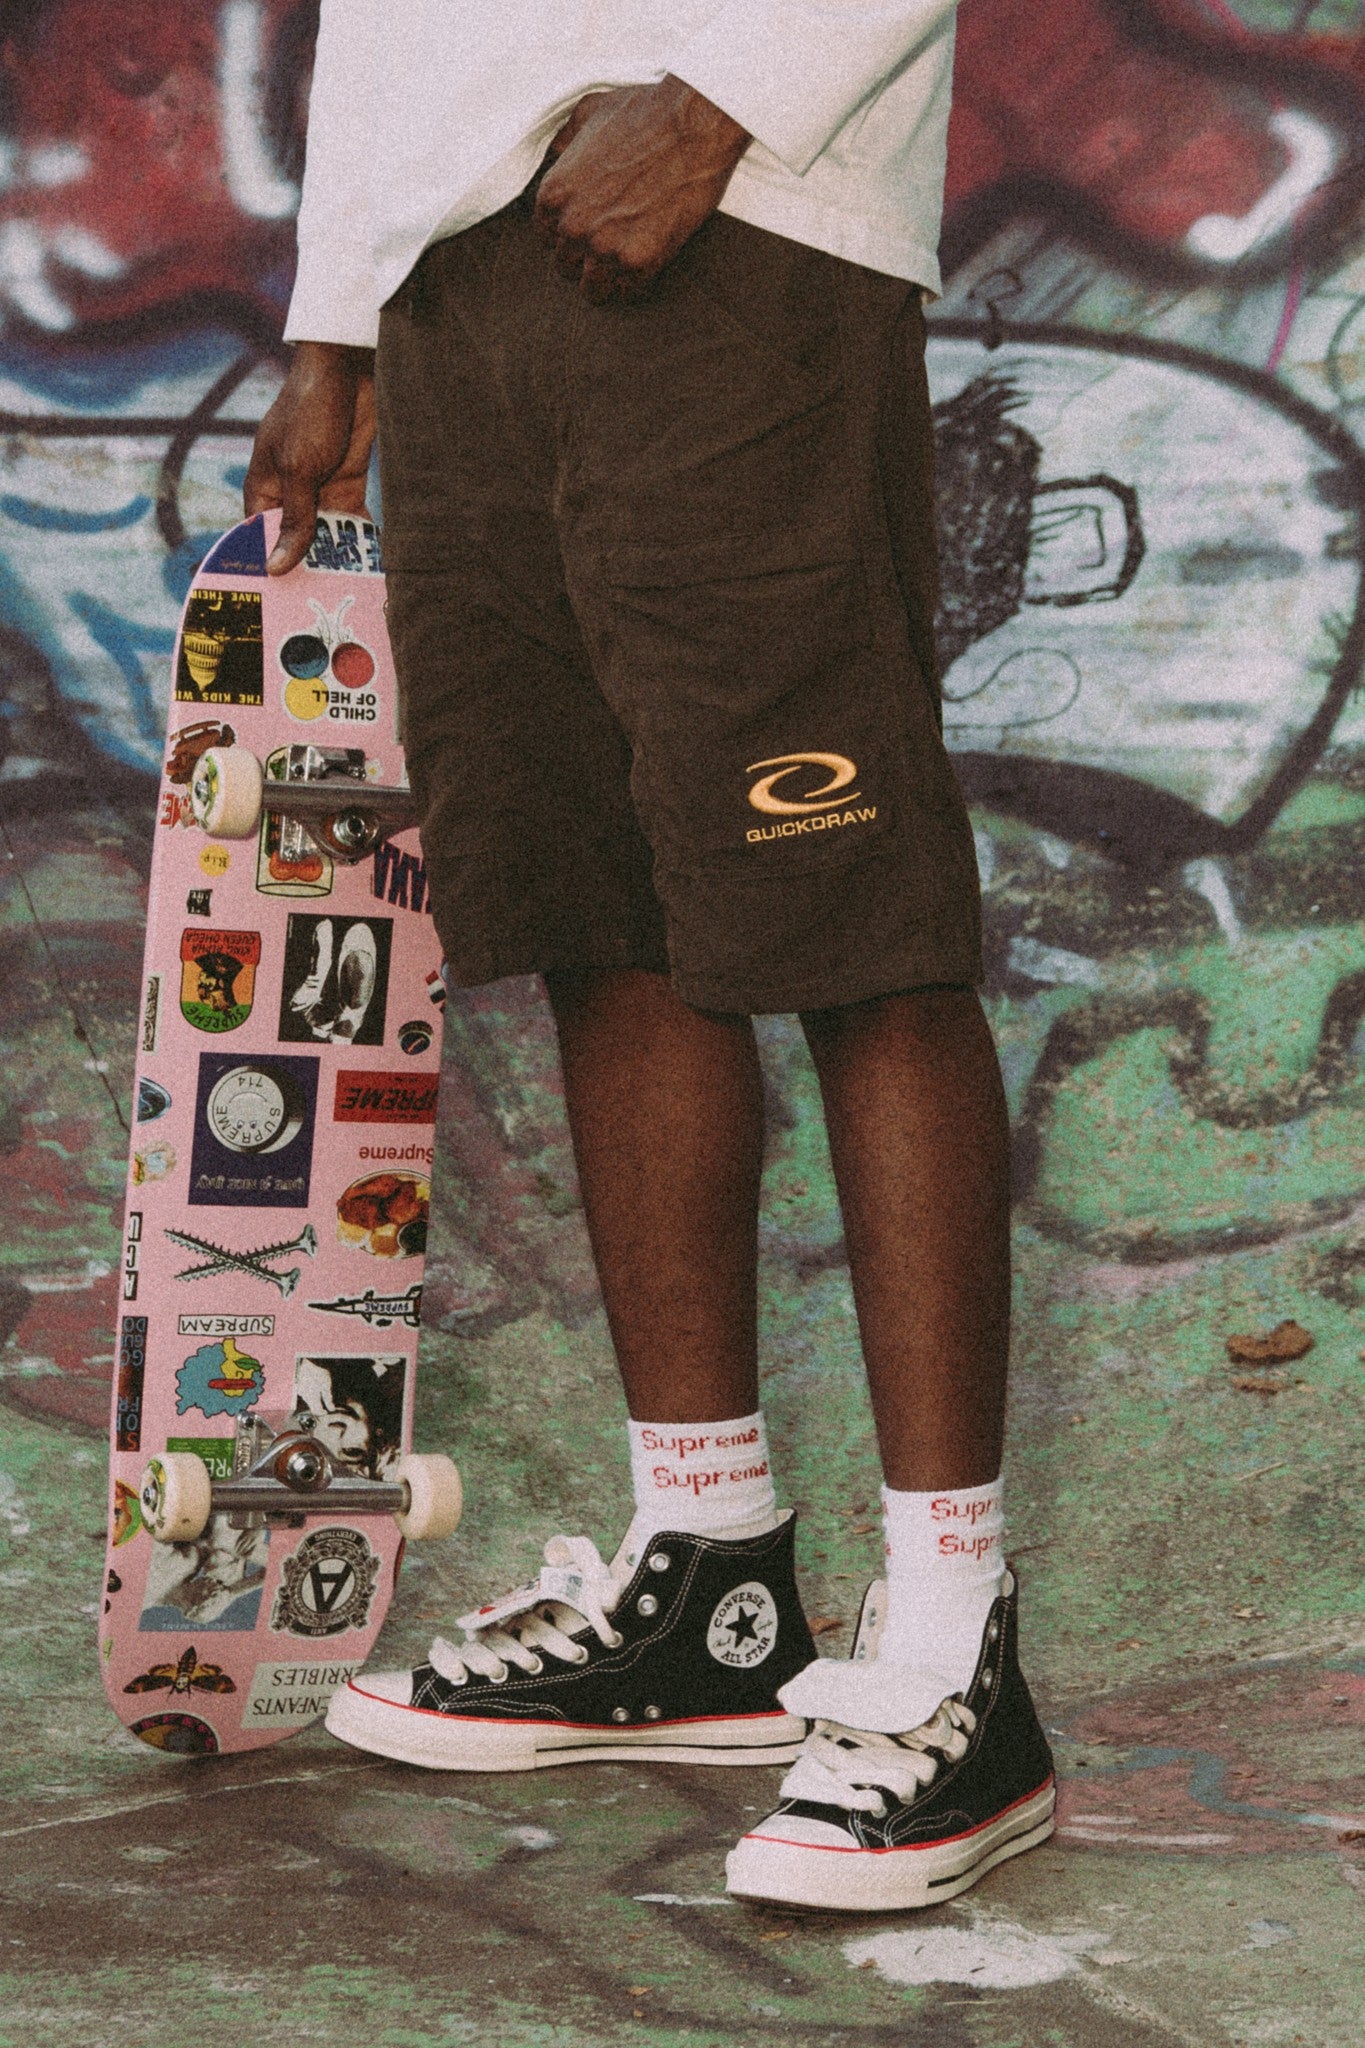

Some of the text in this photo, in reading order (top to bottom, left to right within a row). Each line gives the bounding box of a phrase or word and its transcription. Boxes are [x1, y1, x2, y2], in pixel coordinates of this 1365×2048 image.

[231, 592, 261, 603] HAVE
[202, 692, 231, 703] KIDS
[239, 694, 261, 705] THE
[312, 690, 376, 706] OF HELL
[330, 707, 376, 721] CHILD
[186, 932, 221, 943] OMEGA
[227, 945, 251, 956] KING
[186, 1006, 244, 1029] SUPREME
[238, 1076, 263, 1088] 714
[216, 1105, 280, 1144] SUPREME
[359, 1144, 434, 1165] Supreme
[181, 1317, 272, 1334] SUPREAM
[641, 1427, 759, 1458] Supreme
[653, 1460, 769, 1495] Supreme
[308, 1562, 353, 1615] A
[714, 1591, 766, 1628] CONVERSE
[721, 1650, 742, 1664] ALL
[745, 1636, 771, 1663] STAR
[272, 1667, 358, 1688] RRIBLES
